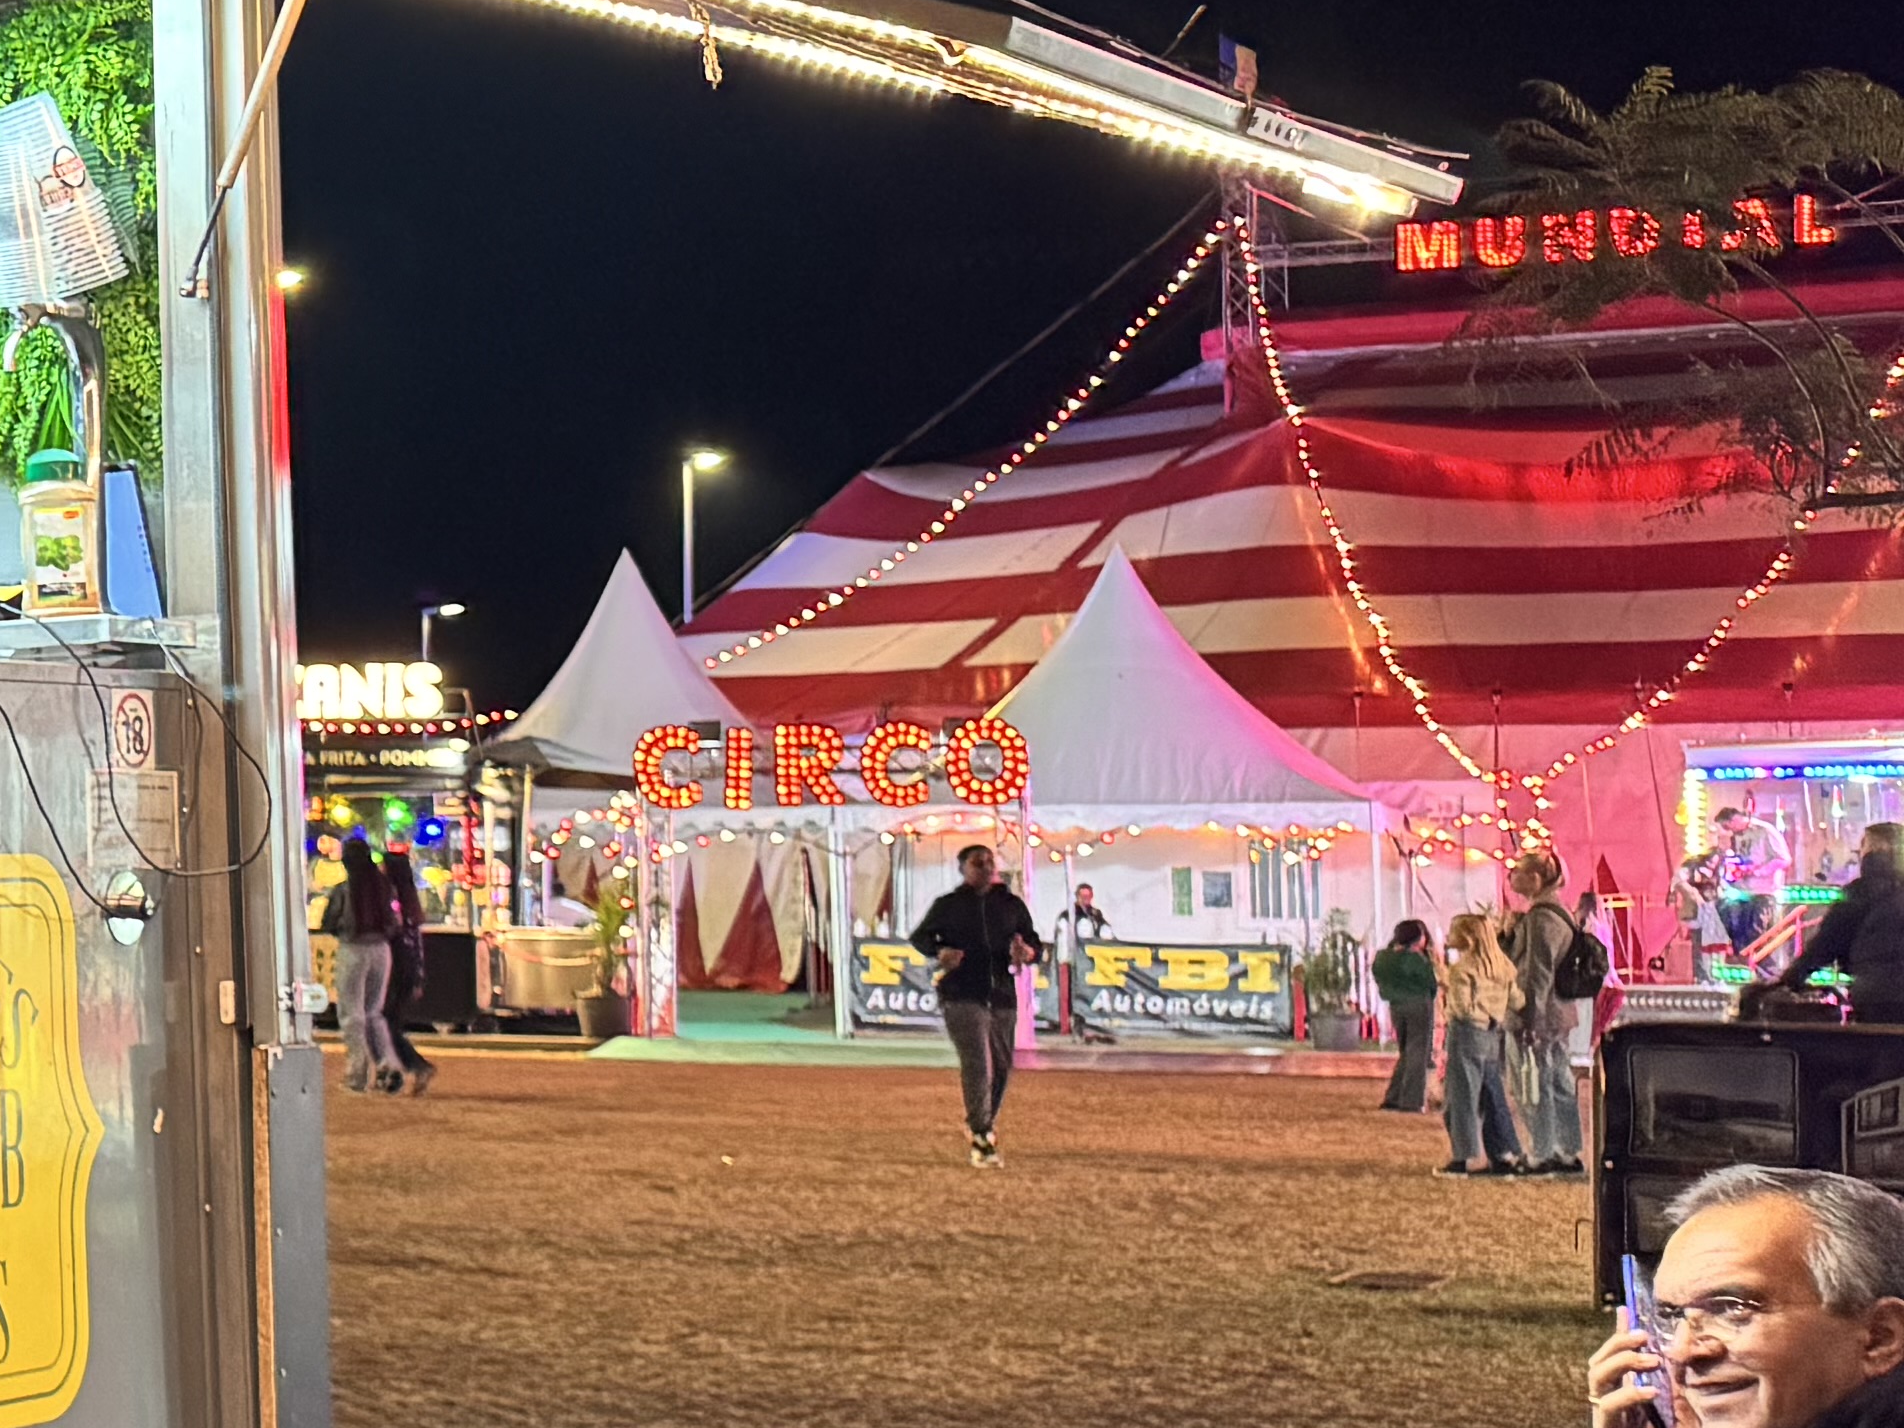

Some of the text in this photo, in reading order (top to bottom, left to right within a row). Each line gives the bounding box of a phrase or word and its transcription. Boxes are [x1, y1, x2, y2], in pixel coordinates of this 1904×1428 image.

[1394, 193, 1837, 272] MUNDIAL
[632, 716, 1030, 811] CIRCO
[1086, 944, 1280, 993] FBI
[1091, 986, 1273, 1021] Automóveis
